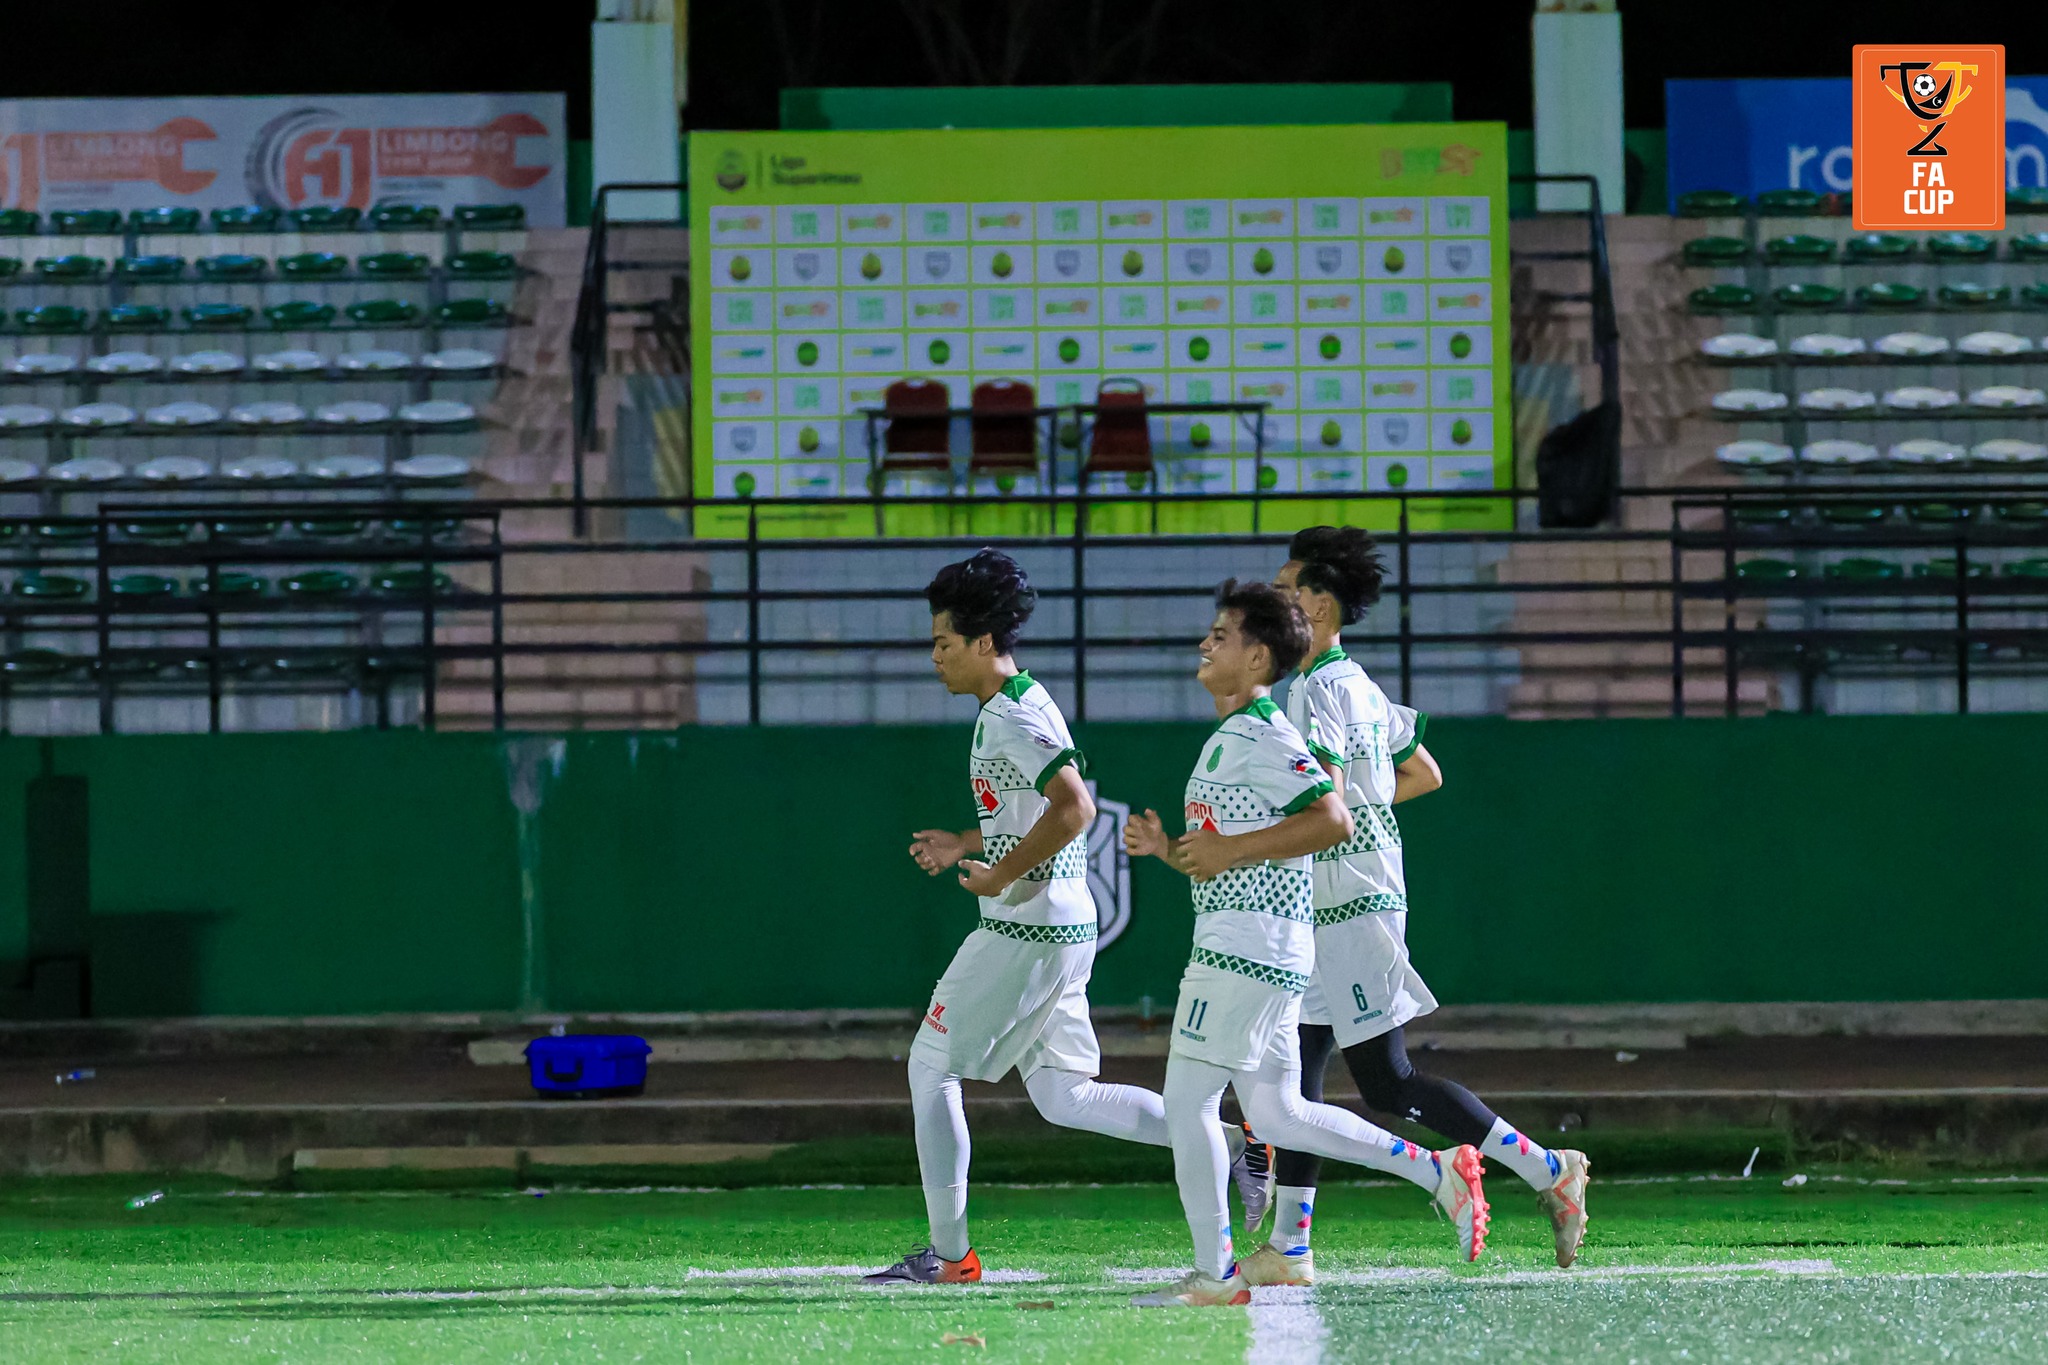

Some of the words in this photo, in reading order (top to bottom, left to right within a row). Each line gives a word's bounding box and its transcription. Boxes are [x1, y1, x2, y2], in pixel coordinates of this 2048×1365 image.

[381, 130, 510, 154] LIMBONG
[1352, 983, 1368, 1012] 6
[1187, 998, 1208, 1030] 11
